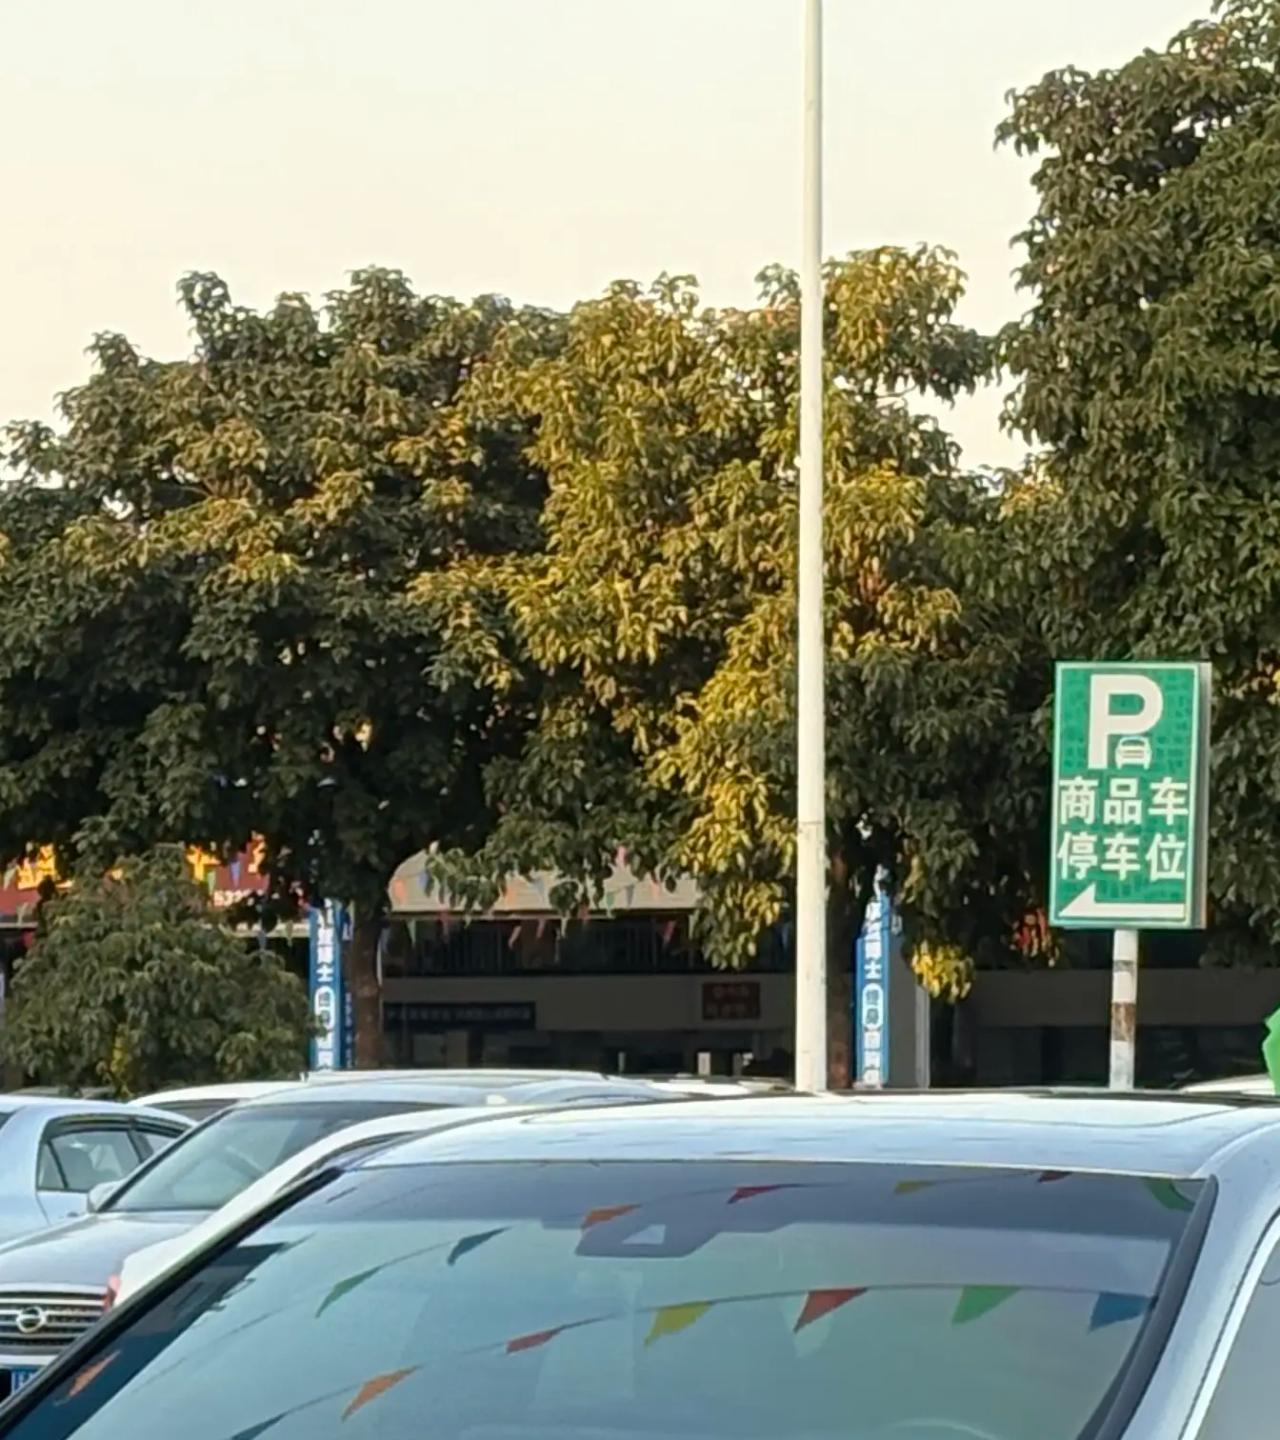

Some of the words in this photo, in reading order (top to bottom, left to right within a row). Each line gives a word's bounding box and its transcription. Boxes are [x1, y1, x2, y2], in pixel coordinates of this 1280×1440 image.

[1087, 673, 1164, 770] P
[1058, 776, 1190, 826] 商品车
[1056, 832, 1187, 882] 停车位
